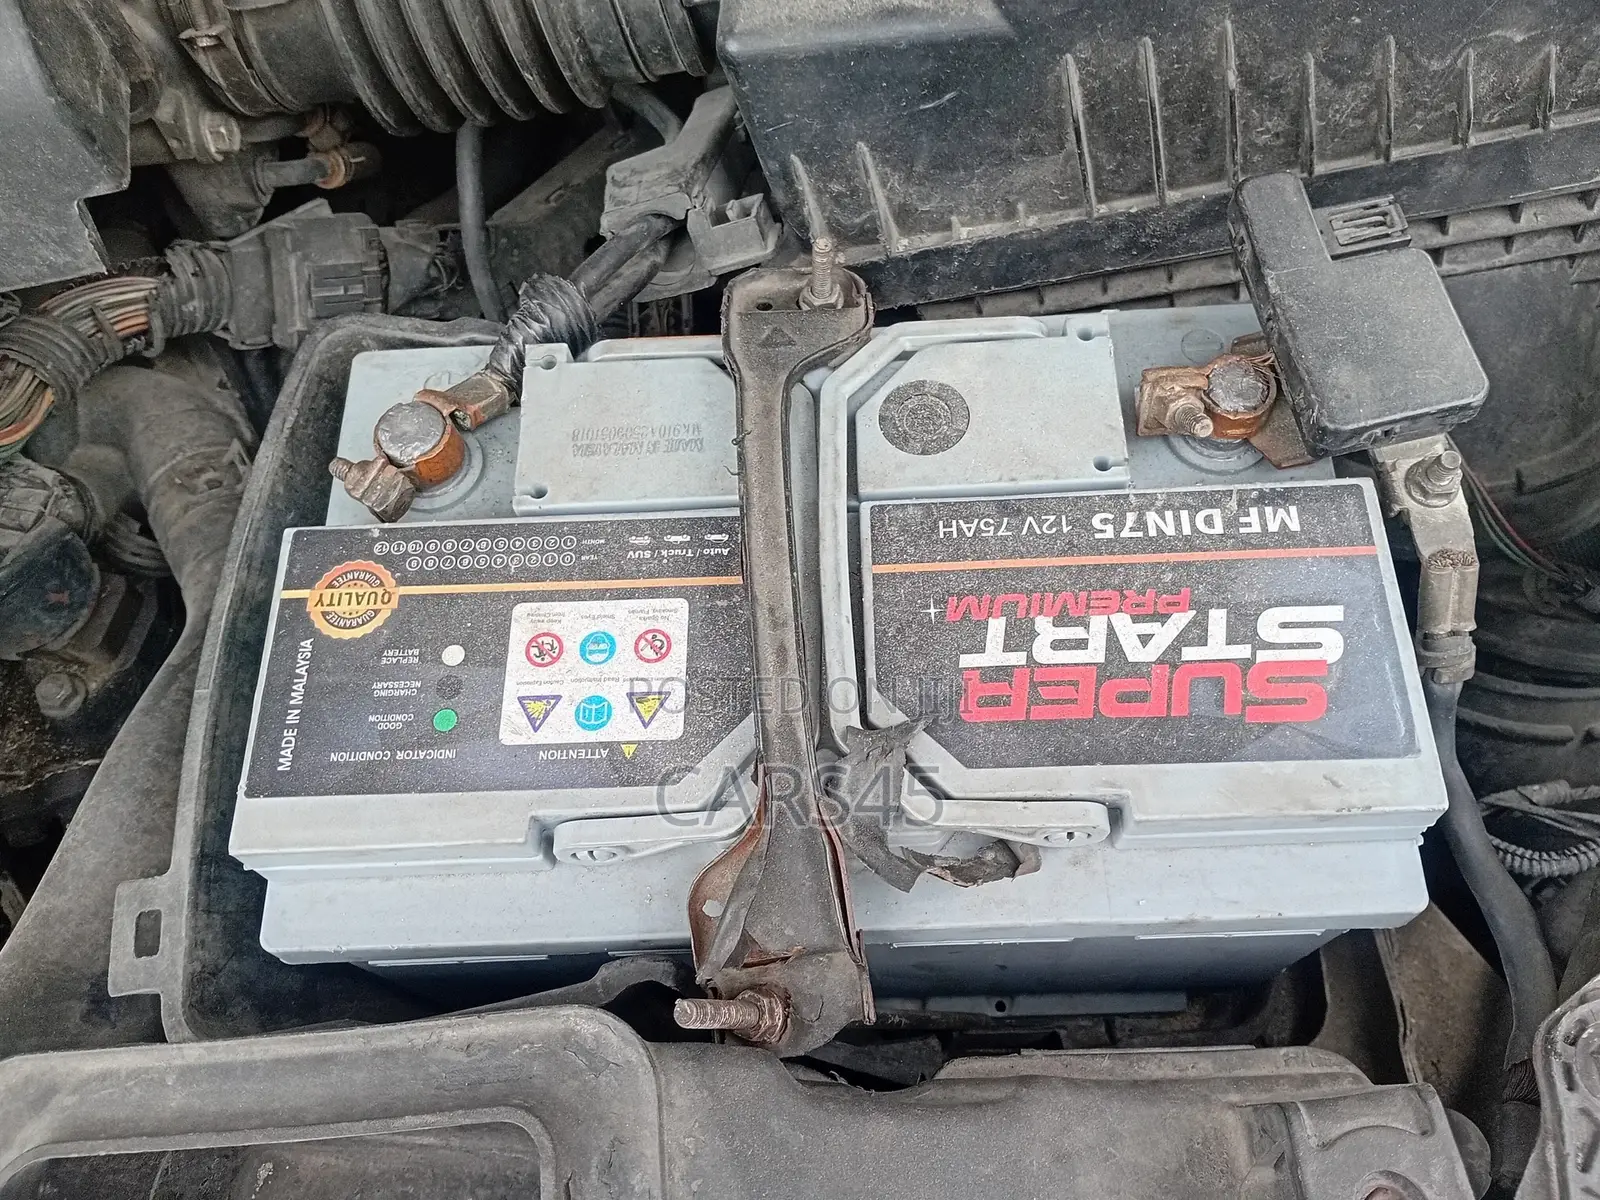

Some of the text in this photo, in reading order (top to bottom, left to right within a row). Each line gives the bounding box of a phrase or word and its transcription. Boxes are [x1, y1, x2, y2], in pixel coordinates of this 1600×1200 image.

[939, 515, 1072, 539] 12V 75AH
[1094, 505, 1300, 539] MF DIN75
[627, 550, 651, 559] SUV
[661, 549, 694, 557] Truck
[703, 548, 730, 556] Auto
[332, 571, 380, 587] GUARANTEE
[314, 588, 392, 607] QUALITY
[946, 587, 1191, 621] PREMIUM
[326, 609, 375, 628] GUARANTEE
[958, 604, 1345, 668] START
[381, 656, 419, 664] REPLACE
[371, 680, 421, 689] NECESSARY
[959, 659, 1329, 723] SUPER
[373, 689, 417, 697] CHARGING
[277, 638, 314, 771] MADE IN MALAYSIA
[368, 714, 414, 722] CONDITION
[377, 722, 403, 730] GOOD
[330, 749, 456, 762] INDICATOR CONDITION
[539, 748, 609, 760] ATTENTION
